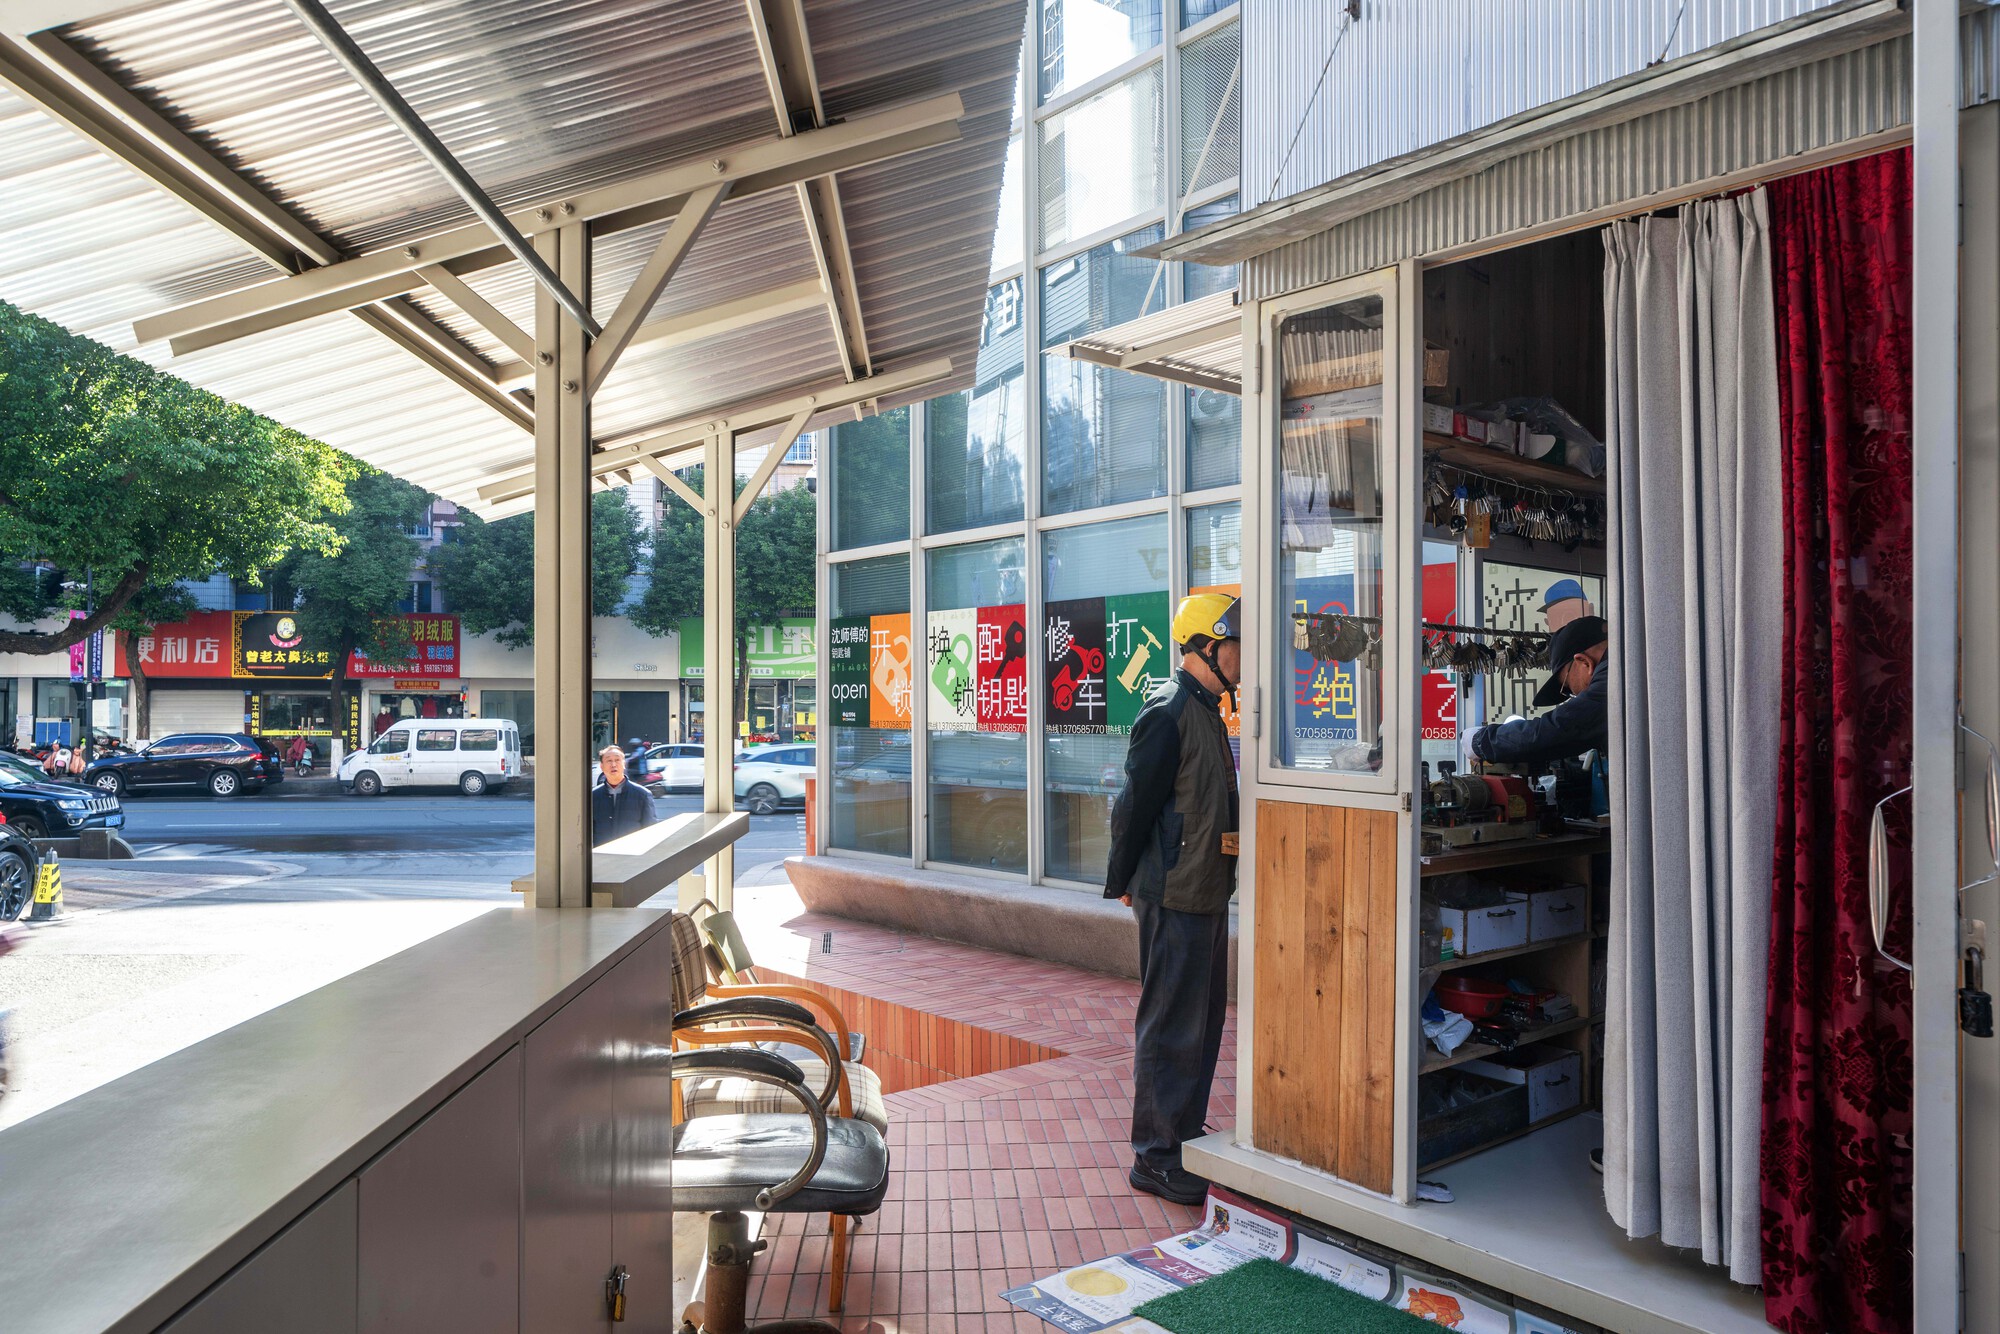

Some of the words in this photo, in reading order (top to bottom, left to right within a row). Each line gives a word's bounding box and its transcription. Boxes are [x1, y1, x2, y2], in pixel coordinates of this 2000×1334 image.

[831, 626, 869, 644] 沈师傅的
[871, 629, 892, 667] 开
[929, 625, 951, 665] 换
[977, 623, 1003, 664] 配
[1045, 616, 1075, 661] 修
[1106, 611, 1138, 659] 打
[831, 684, 868, 703] open
[892, 677, 912, 718] 锁
[952, 676, 976, 717] 锁
[977, 675, 1028, 719] 钥匙
[1075, 674, 1106, 721] 车
